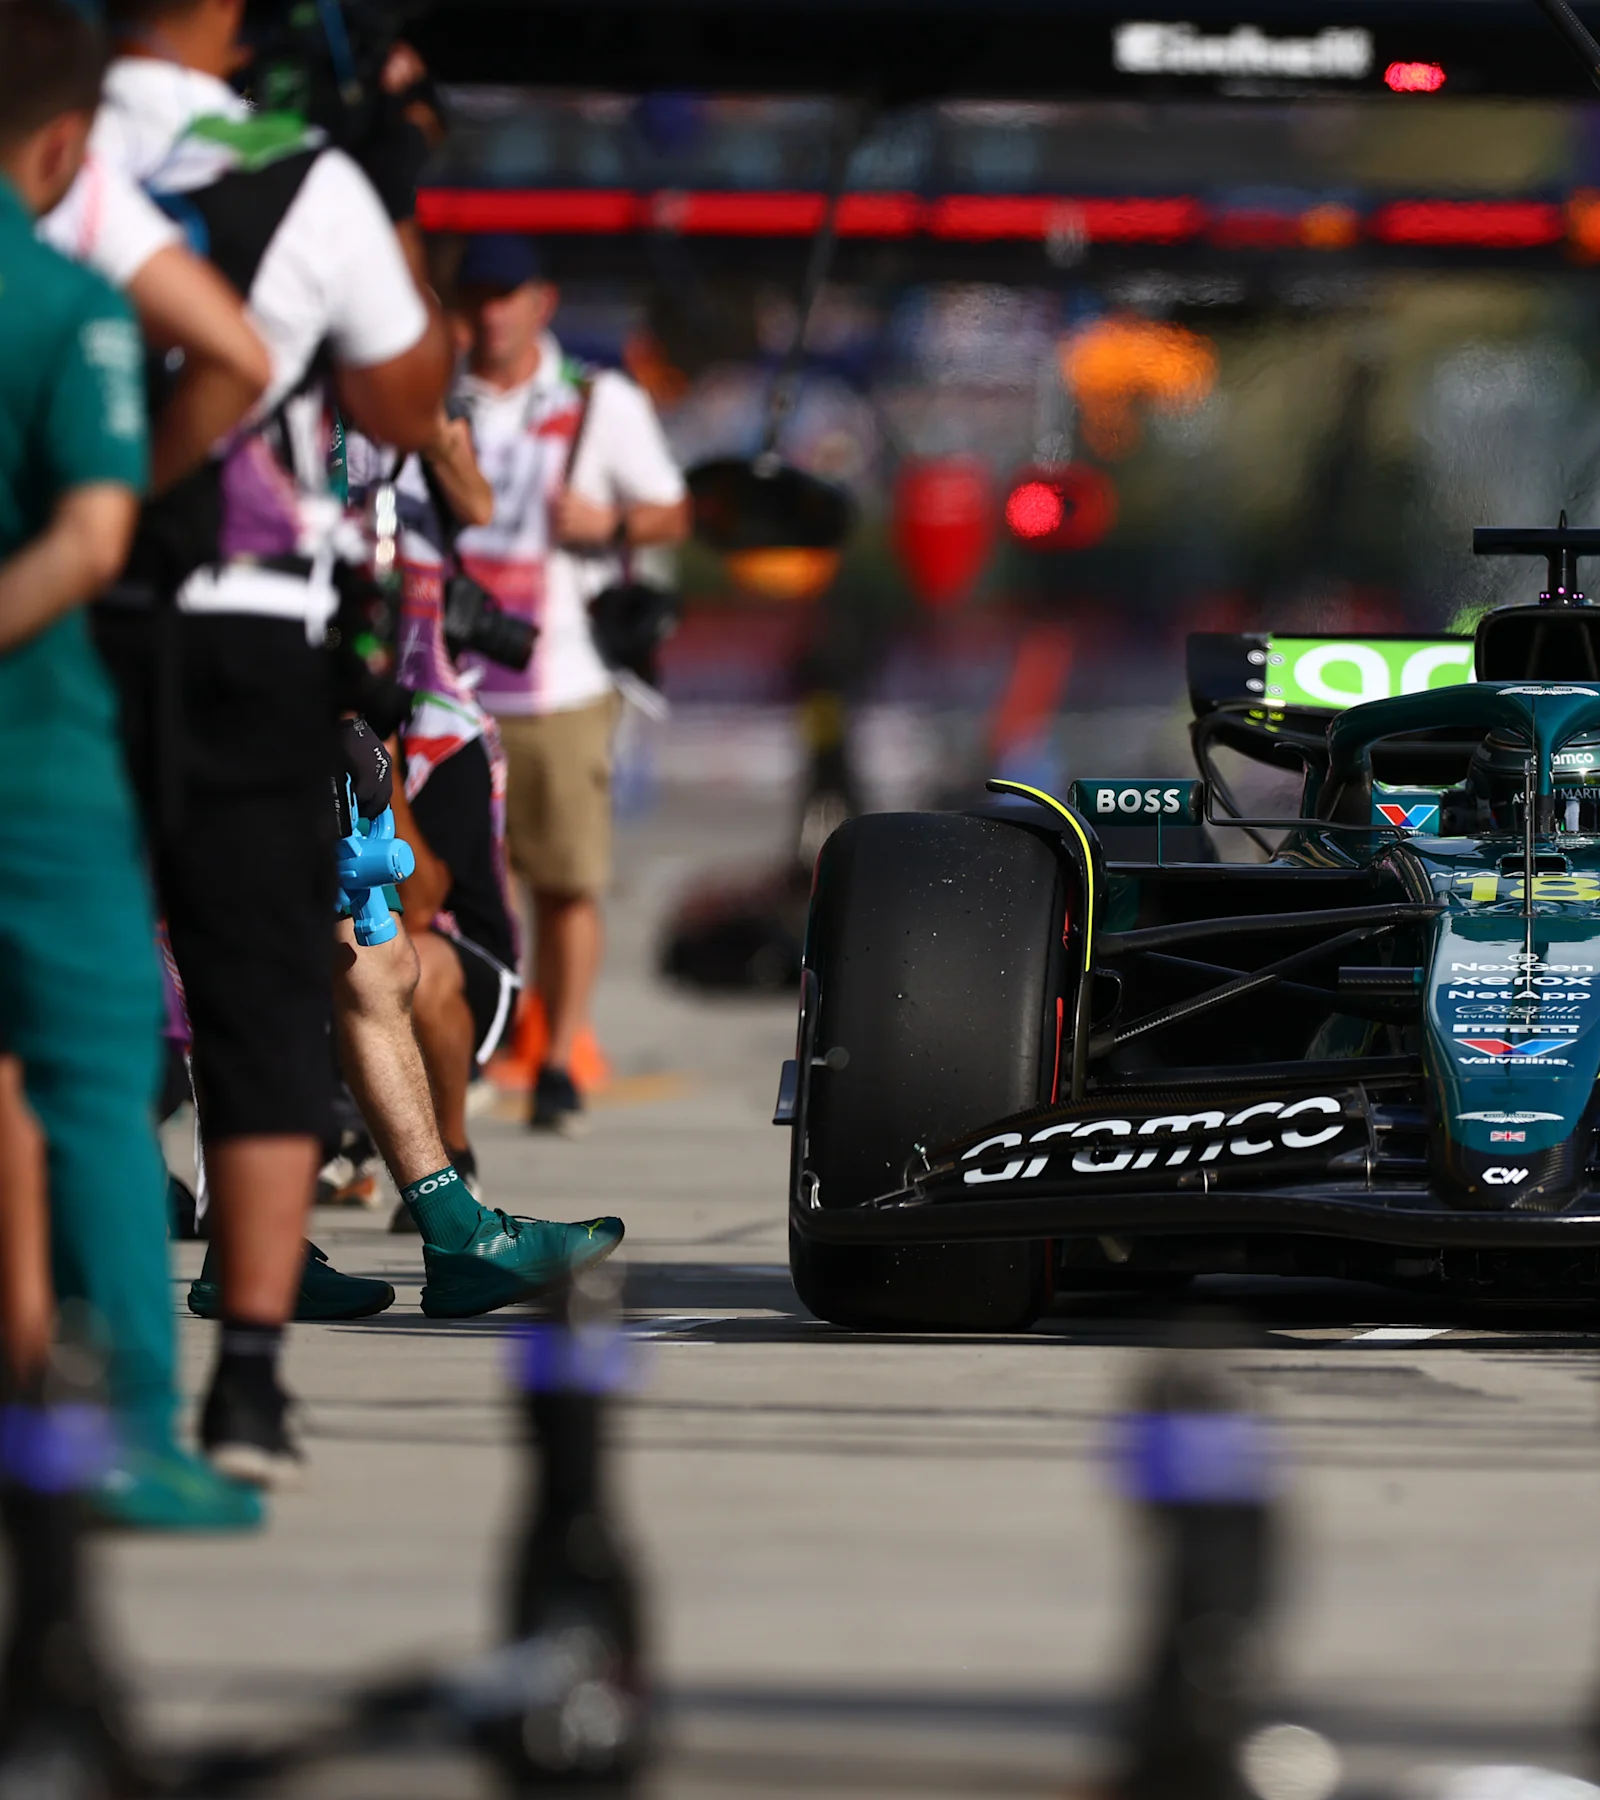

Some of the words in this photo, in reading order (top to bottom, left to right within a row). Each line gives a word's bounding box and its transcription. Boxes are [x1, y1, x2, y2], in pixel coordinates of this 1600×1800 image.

[1097, 788, 1181, 813] BOSS
[1451, 963, 1594, 972] NexGen
[1451, 976, 1592, 986] xerox
[1448, 990, 1591, 1001] NetApp
[1458, 1056, 1568, 1066] Valvoline
[961, 1096, 1345, 1184] aramco
[405, 1170, 458, 1203] BOSS
